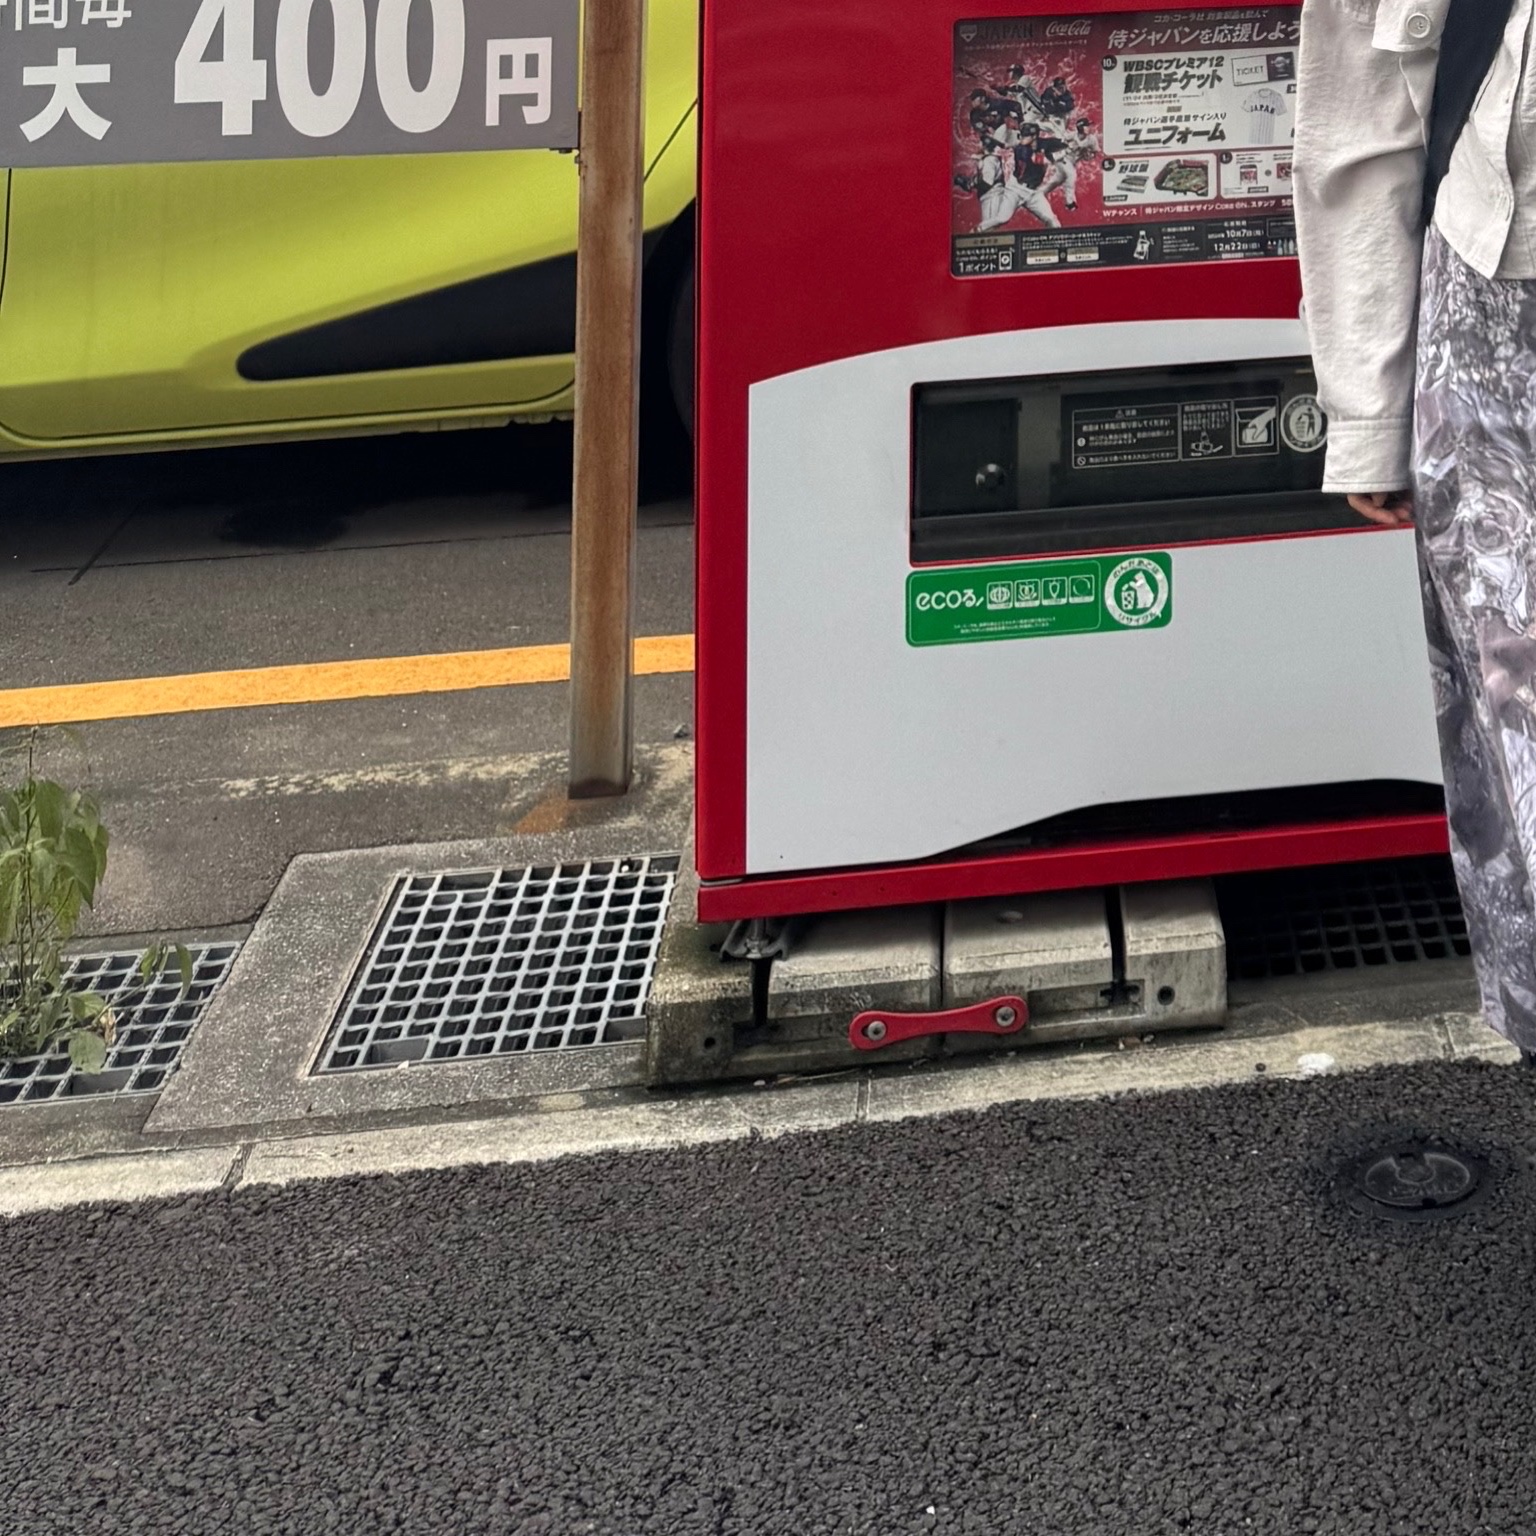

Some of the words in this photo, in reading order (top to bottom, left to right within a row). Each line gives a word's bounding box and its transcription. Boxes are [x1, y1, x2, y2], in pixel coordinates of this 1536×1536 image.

[1046, 19, 1092, 37] Coca-Cola
[1123, 55, 1225, 72] WBSCプレミア12
[1123, 69, 1224, 94] 観戦チケット
[19, 47, 112, 143] 大
[1250, 104, 1276, 114] JAPAN
[1124, 123, 1227, 146] ユニフォーム
[958, 262, 997, 273] 1ポイント
